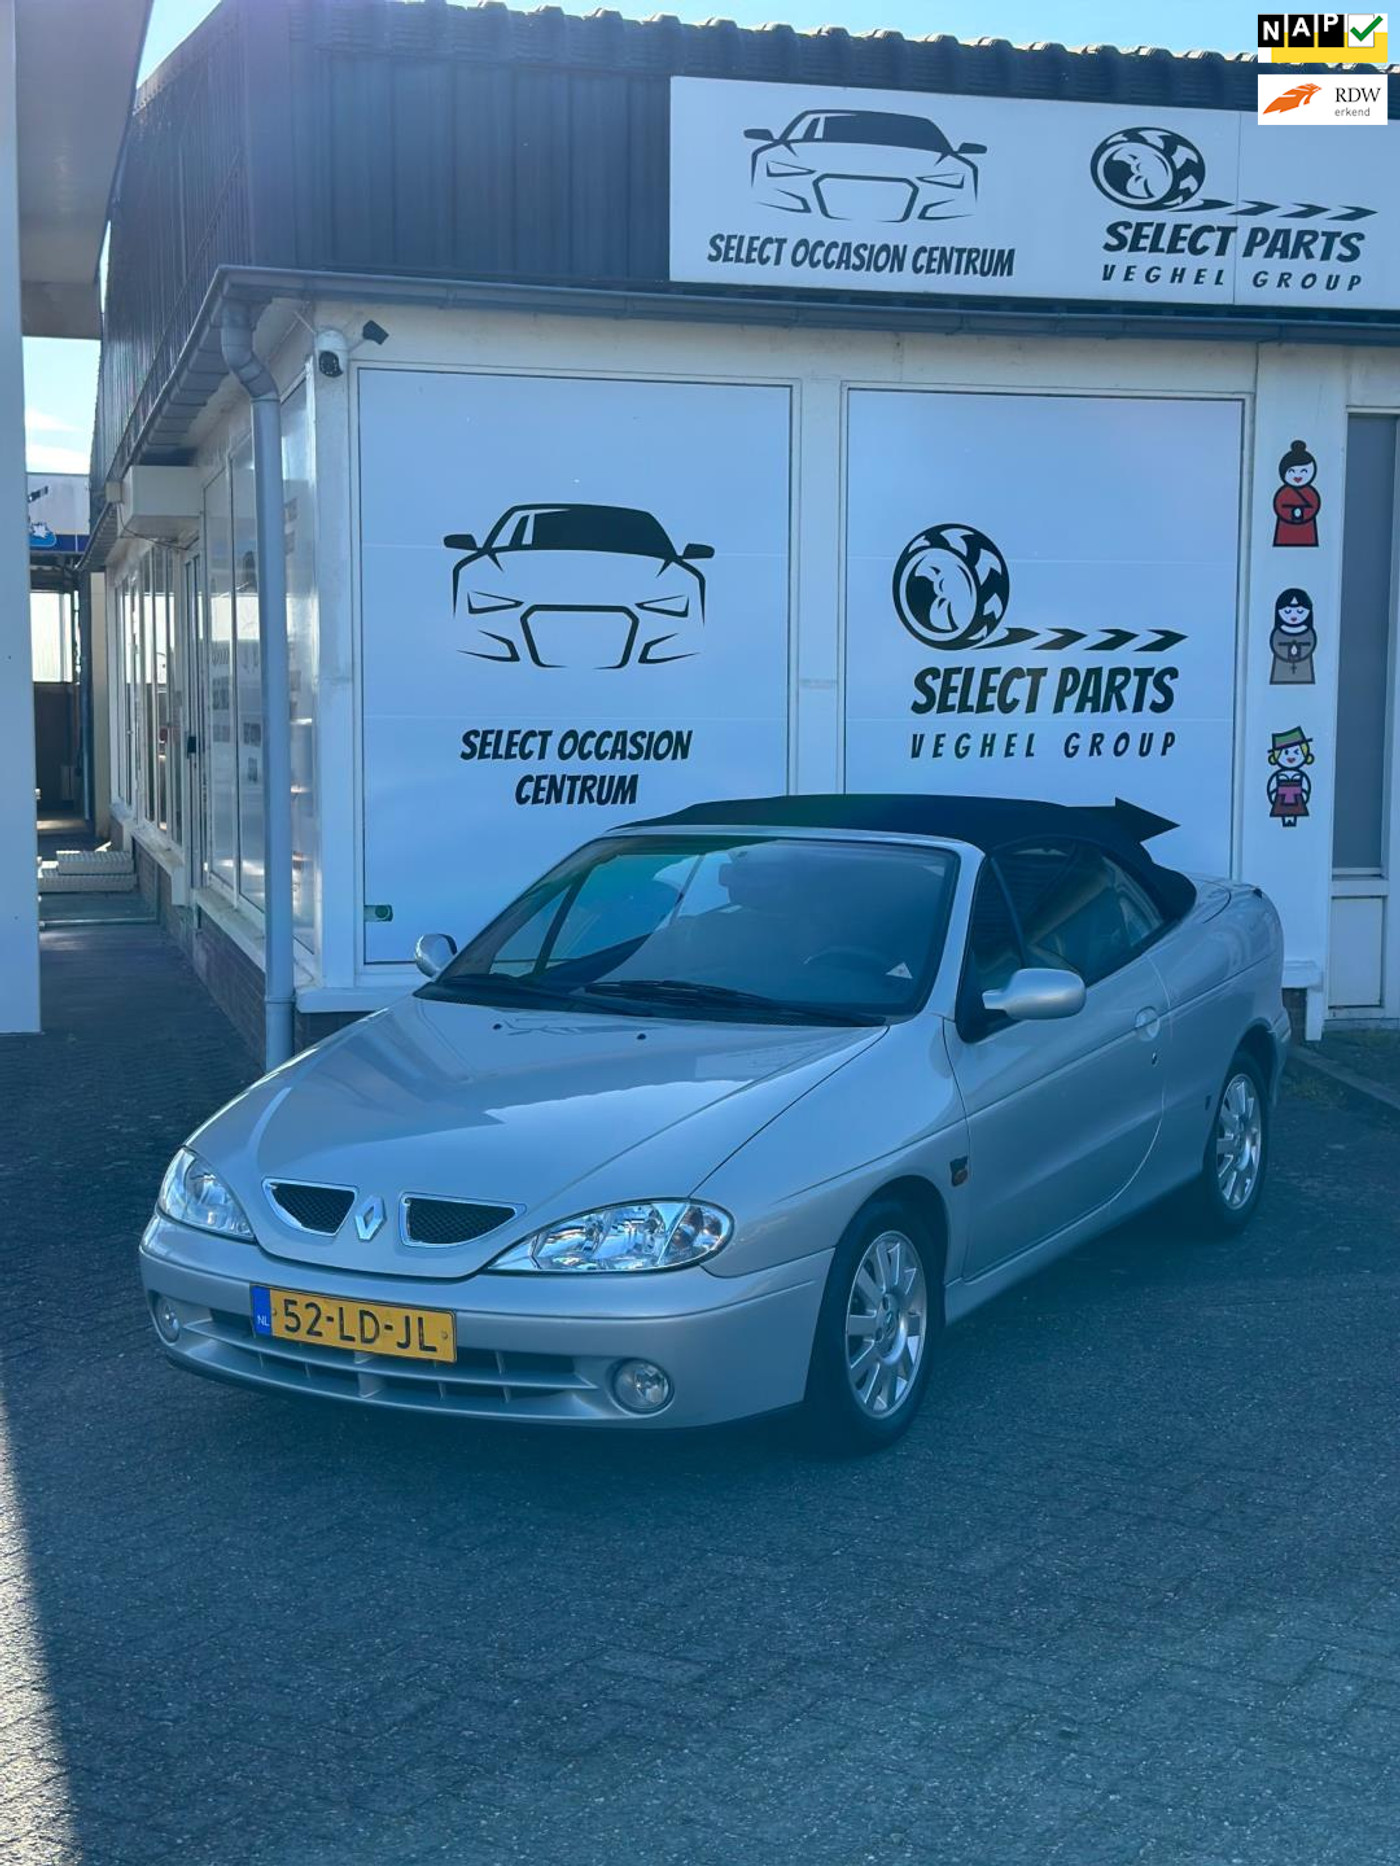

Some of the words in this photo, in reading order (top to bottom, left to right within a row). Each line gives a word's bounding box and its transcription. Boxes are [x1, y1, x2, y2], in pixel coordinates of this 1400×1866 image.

[707, 233, 787, 266] SELECT
[790, 238, 908, 272] OCCASION
[911, 246, 1016, 277] CENTRUM
[1102, 220, 1238, 257] SELECT
[1242, 226, 1365, 263] PARTS
[1102, 264, 1224, 286] VEGHEL
[1252, 270, 1362, 292] GROUP
[910, 666, 1048, 715] SELECT
[1052, 666, 1179, 714] PARTS
[460, 729, 553, 761] SELECT
[556, 729, 693, 761] OCCASION
[910, 733, 1036, 759] VEGHEL
[1063, 732, 1176, 758] GROUP
[514, 774, 639, 806] CENTRUM
[257, 1314, 270, 1327] NL
[283, 1298, 438, 1352] 52-LD-JL
